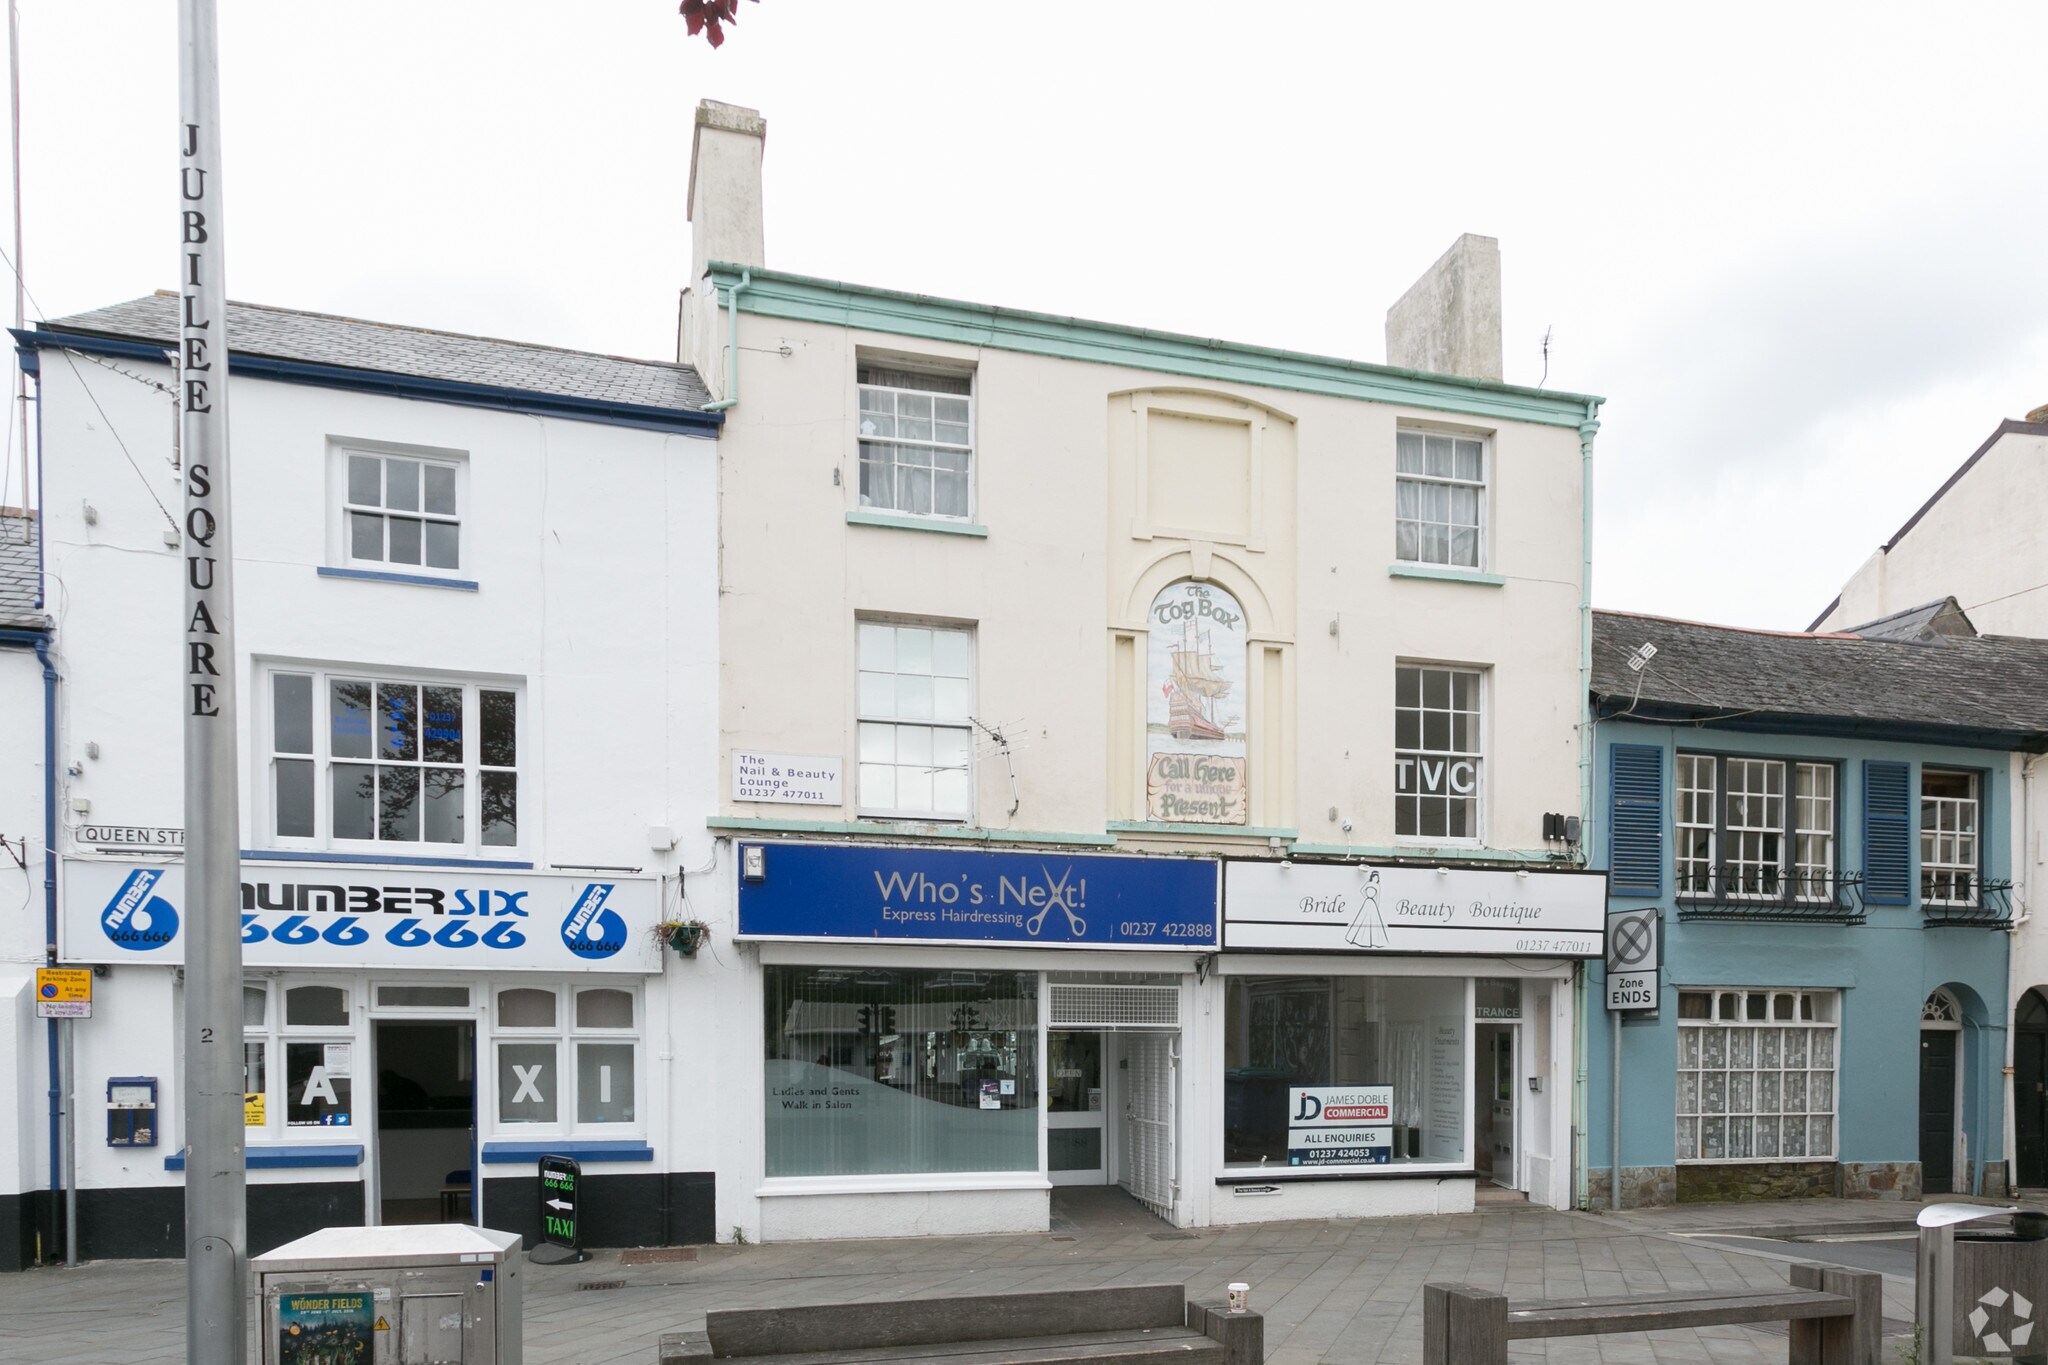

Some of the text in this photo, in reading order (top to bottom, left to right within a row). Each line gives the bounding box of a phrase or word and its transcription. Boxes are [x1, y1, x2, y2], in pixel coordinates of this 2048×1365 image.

[181, 123, 220, 718] JUBILEE SQUARE
[1184, 585, 1212, 598] The
[1198, 599, 1240, 632] Box
[740, 755, 765, 765] The
[740, 766, 835, 781] Nail & Beauty
[1157, 756, 1190, 780] Call
[1395, 758, 1476, 793] TVC
[740, 777, 789, 789] Lounge
[1165, 780, 1182, 792] for
[1184, 783, 1192, 793] a
[740, 788, 825, 800] 01237 477011
[1160, 793, 1237, 819] Present
[86, 828, 150, 843] QUEEN
[874, 870, 984, 905] Who's
[1299, 894, 1543, 925] Bride Beauty Boutique
[882, 906, 1023, 928] Express Hairdressing
[384, 918, 527, 950] 666
[1120, 921, 1213, 937] 01237 422888
[111, 930, 171, 943] 666 666
[569, 940, 620, 952] 666 666
[1516, 939, 1592, 953] 01237 477011
[1619, 978, 1644, 989] Zone
[1612, 990, 1651, 1004] ENDS
[201, 1028, 213, 1043] 2
[809, 1087, 827, 1096] and
[831, 1088, 860, 1097] Gents
[781, 1100, 852, 1110] Walk in Salon
[1325, 1095, 1356, 1106] JAMES
[1357, 1094, 1388, 1105] DOBLE
[1326, 1108, 1387, 1118] COMMERCIAL
[1304, 1133, 1376, 1144] ALL ENQUIRIES
[1309, 1148, 1370, 1158] 01237 424053
[1302, 1156, 1376, 1166] www.jd-commercial.co.uk
[544, 1178, 574, 1192] 666 666
[545, 1215, 574, 1238] TAXI
[332, 1297, 363, 1309] FIELDS
